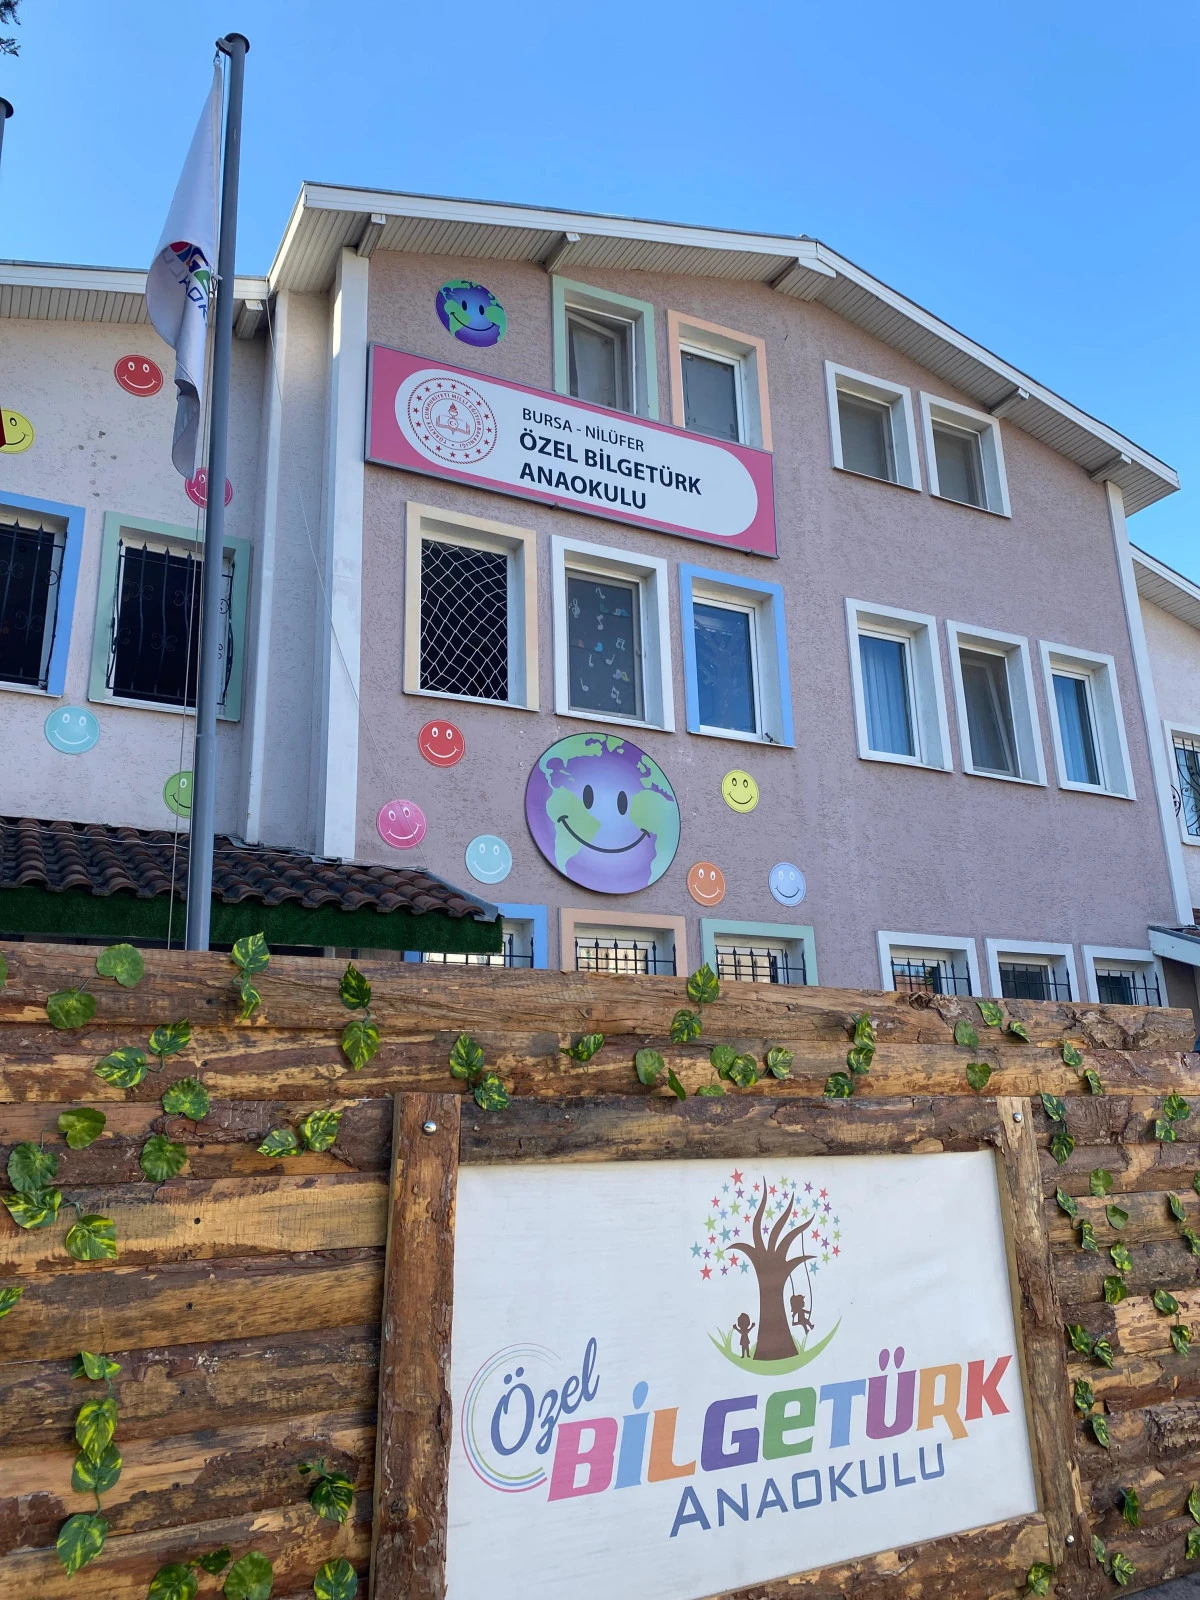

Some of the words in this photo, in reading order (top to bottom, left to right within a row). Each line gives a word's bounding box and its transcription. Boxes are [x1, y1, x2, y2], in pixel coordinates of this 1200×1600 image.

[519, 427, 579, 464] ÖZEL
[584, 448, 702, 496] BİLGETÜRK
[522, 407, 573, 433] BURSA
[586, 424, 646, 453] NİLÜFER
[519, 461, 647, 510] ANAOKULU
[490, 1336, 600, 1455] Özel
[669, 1443, 945, 1538] ANAOKULU
